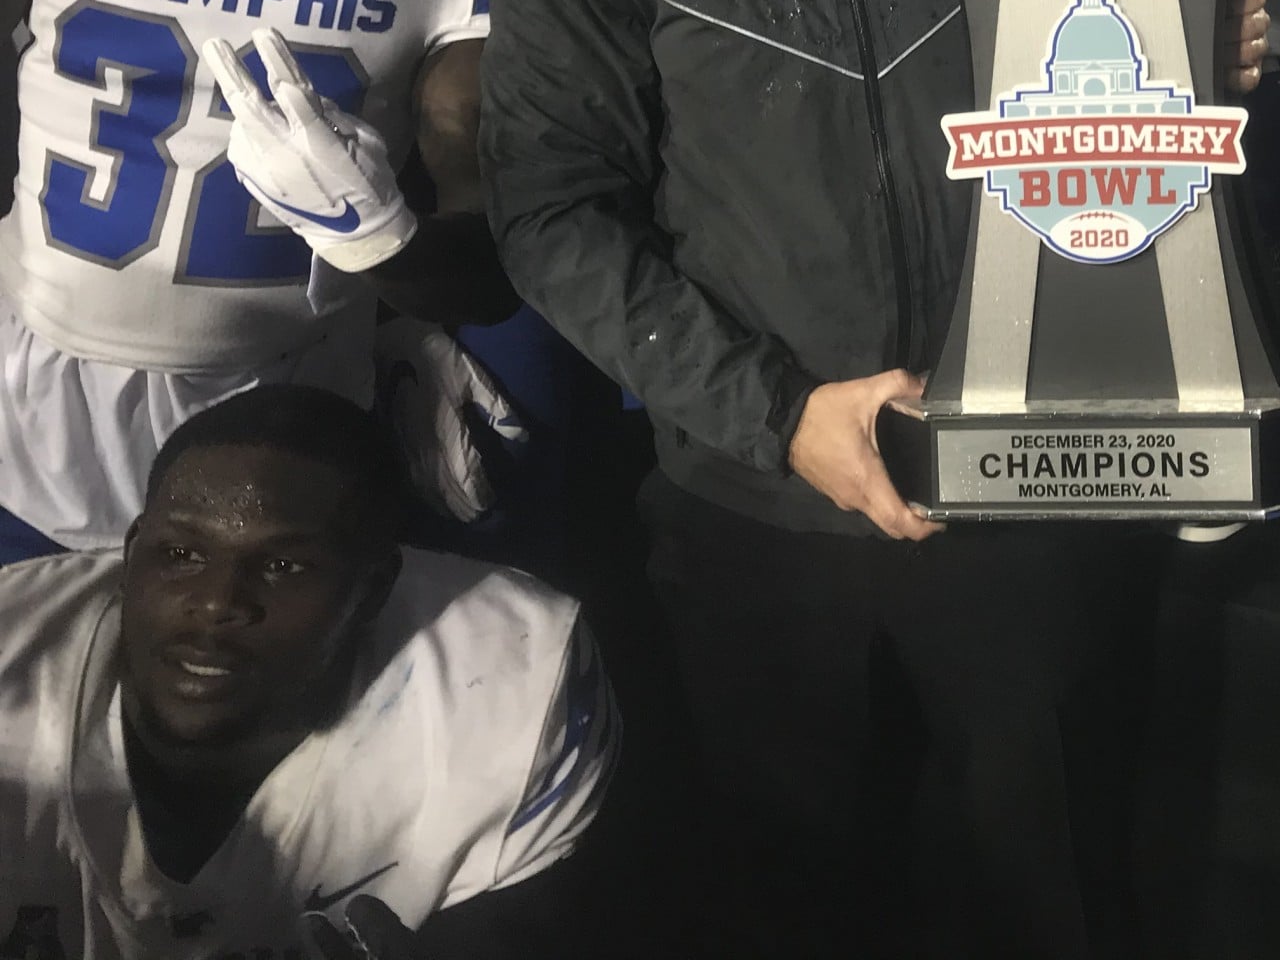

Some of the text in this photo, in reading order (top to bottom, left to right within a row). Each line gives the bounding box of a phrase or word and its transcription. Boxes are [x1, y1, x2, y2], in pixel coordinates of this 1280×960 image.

[958, 123, 1232, 161] MONTGOMERY
[1018, 167, 1177, 208] BOWL
[1069, 228, 1129, 249] 2020
[1010, 434, 1176, 451] DECEMBER 23, 2020
[979, 452, 1211, 479] CHAMPIONS
[1018, 483, 1172, 499] MONTGOMERY, AL
